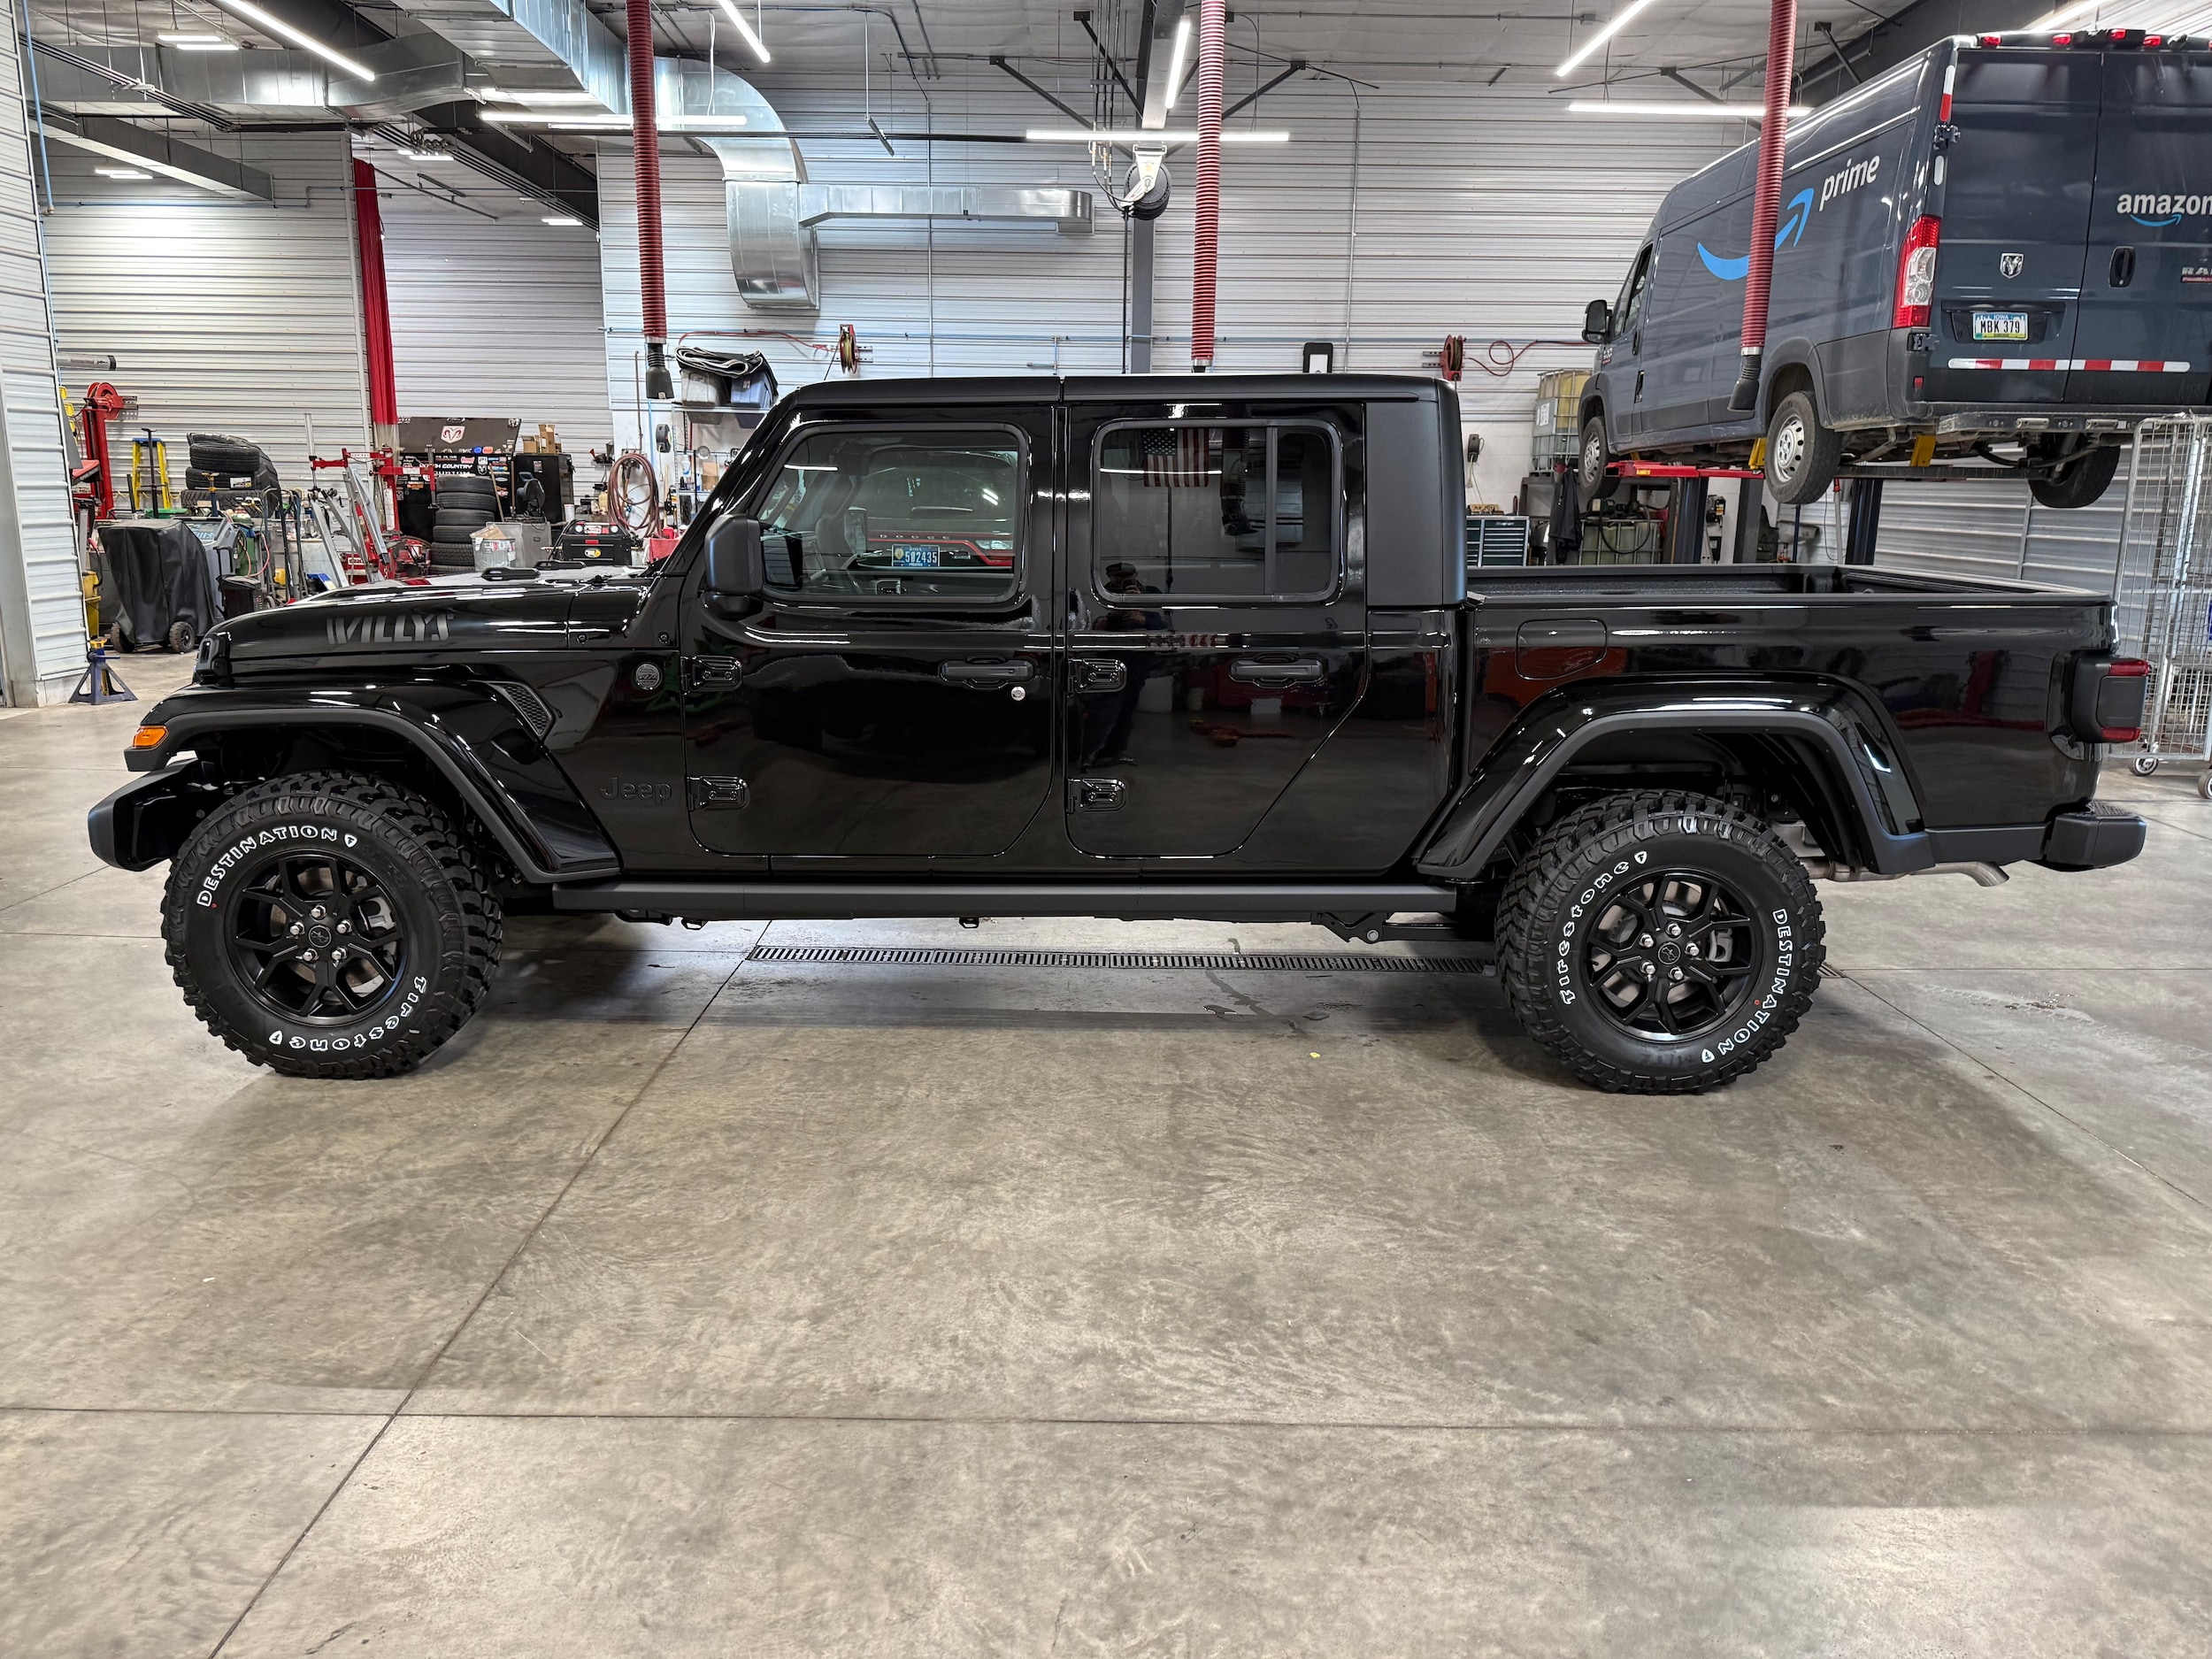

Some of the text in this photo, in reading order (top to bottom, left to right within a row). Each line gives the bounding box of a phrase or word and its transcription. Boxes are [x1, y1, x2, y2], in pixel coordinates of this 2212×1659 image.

[1819, 156, 1880, 211] prime
[2116, 194, 2212, 215] amazon
[1980, 320, 2020, 334] MBK 379
[904, 551, 938, 564] 502435
[326, 614, 455, 644] WILLYS
[600, 778, 672, 805] Jeep
[196, 825, 337, 907] DESTINATION
[1717, 909, 1793, 1056] DESTINATION
